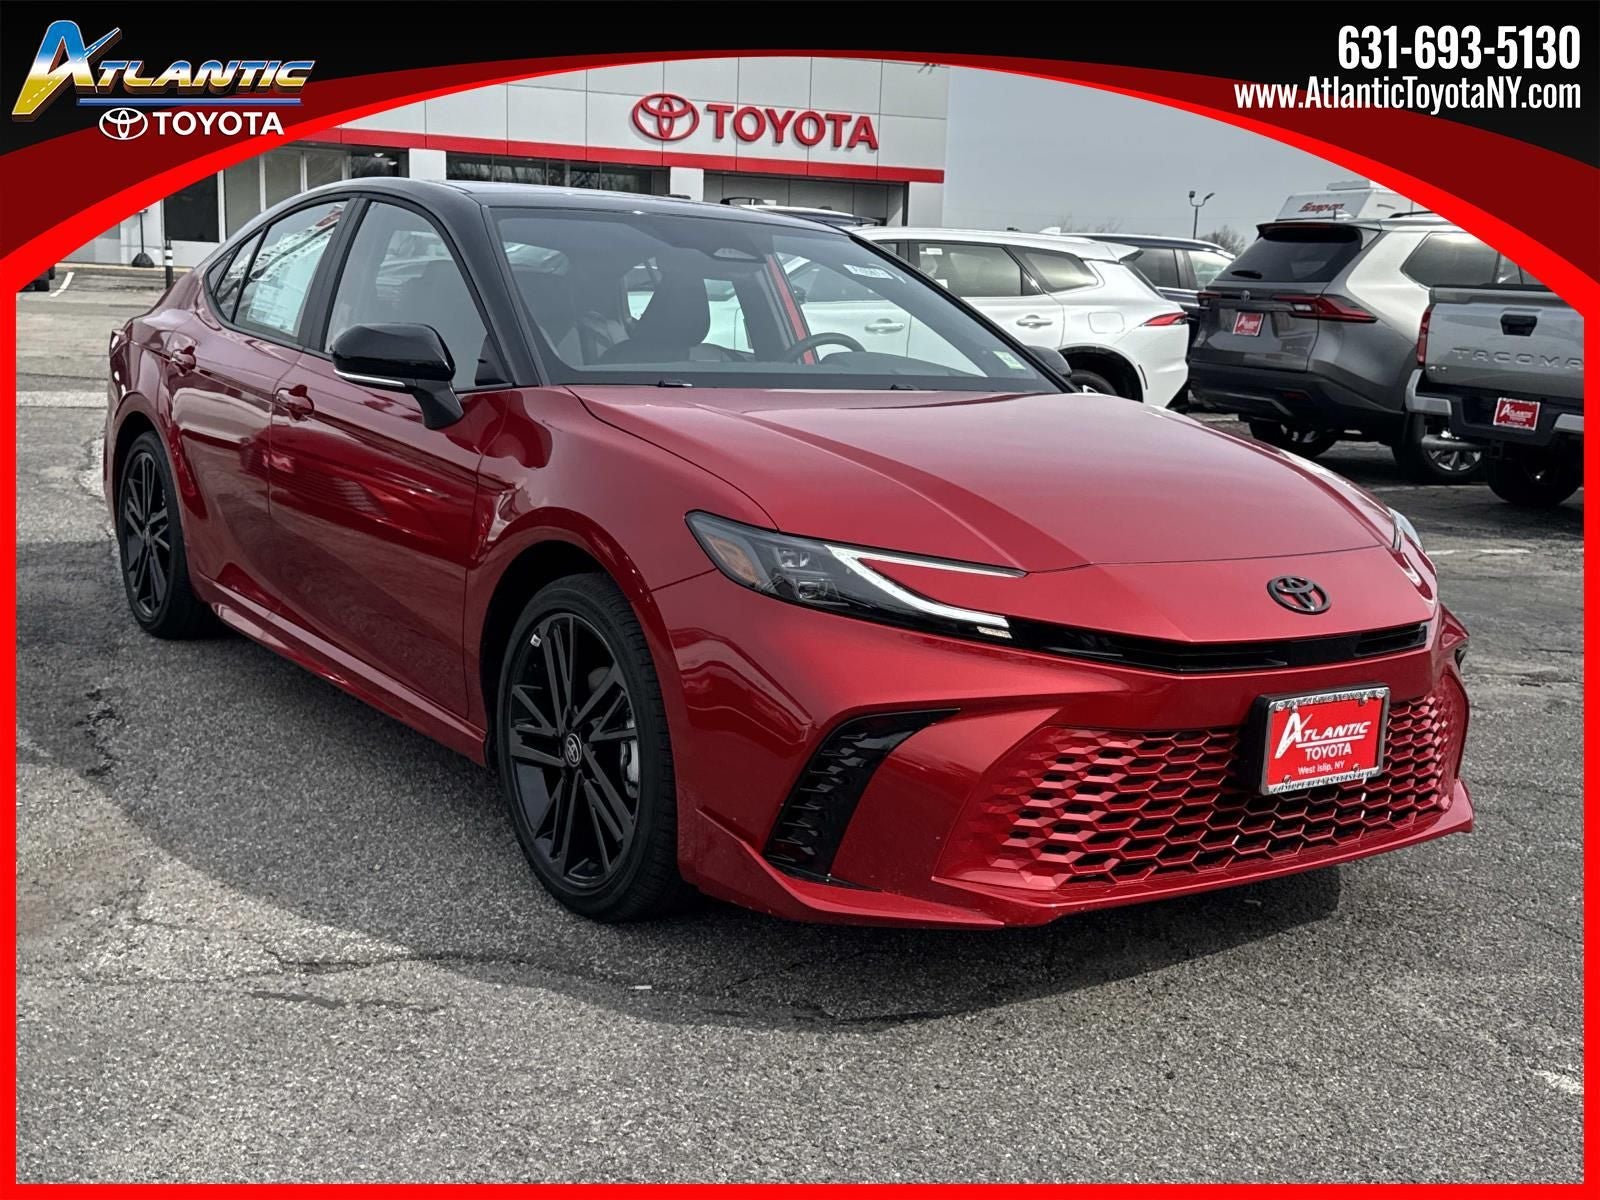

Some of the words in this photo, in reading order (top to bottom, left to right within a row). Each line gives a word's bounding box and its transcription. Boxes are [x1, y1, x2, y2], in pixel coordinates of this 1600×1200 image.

[706, 103, 879, 150] TOYOTA
[1452, 347, 1584, 371] TACOMA
[1275, 712, 1371, 759] ATLANTIC
[1305, 742, 1352, 761] TOYOTA
[1298, 765, 1316, 775] West
[1317, 762, 1333, 773] Islip,
[1334, 760, 1345, 769] NY
